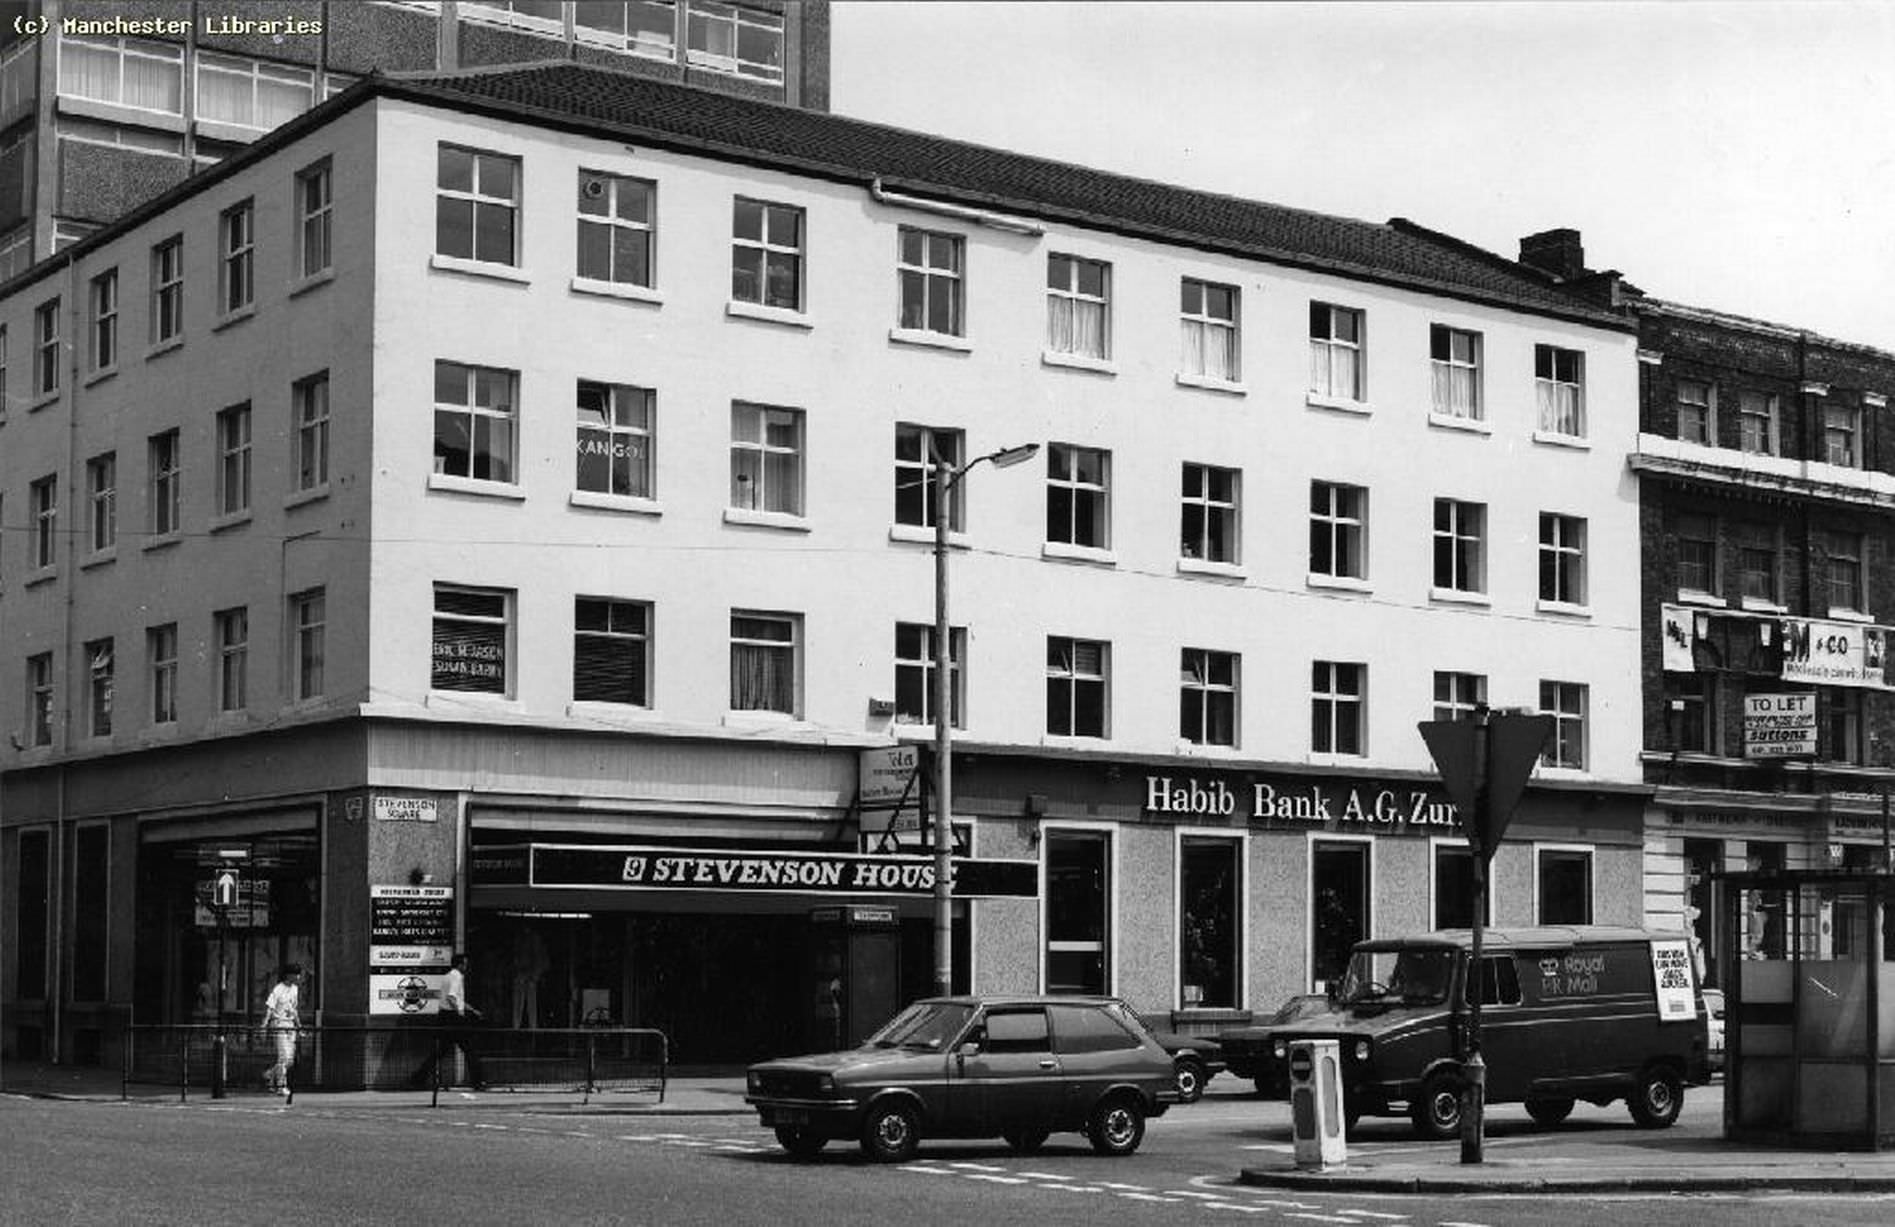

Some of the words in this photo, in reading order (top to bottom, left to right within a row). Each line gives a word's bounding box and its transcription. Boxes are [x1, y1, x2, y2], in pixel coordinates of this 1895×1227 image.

[1751, 698, 1772, 711] TO
[1777, 696, 1807, 711] LET
[379, 799, 436, 810] STEVENSON
[1147, 776, 1236, 816] Habib
[1253, 783, 1332, 821] Bank
[1343, 788, 1404, 824] A.G.
[653, 857, 845, 887] STEVENSON
[1564, 955, 1605, 975] Royal
[1567, 975, 1599, 994] Mail
